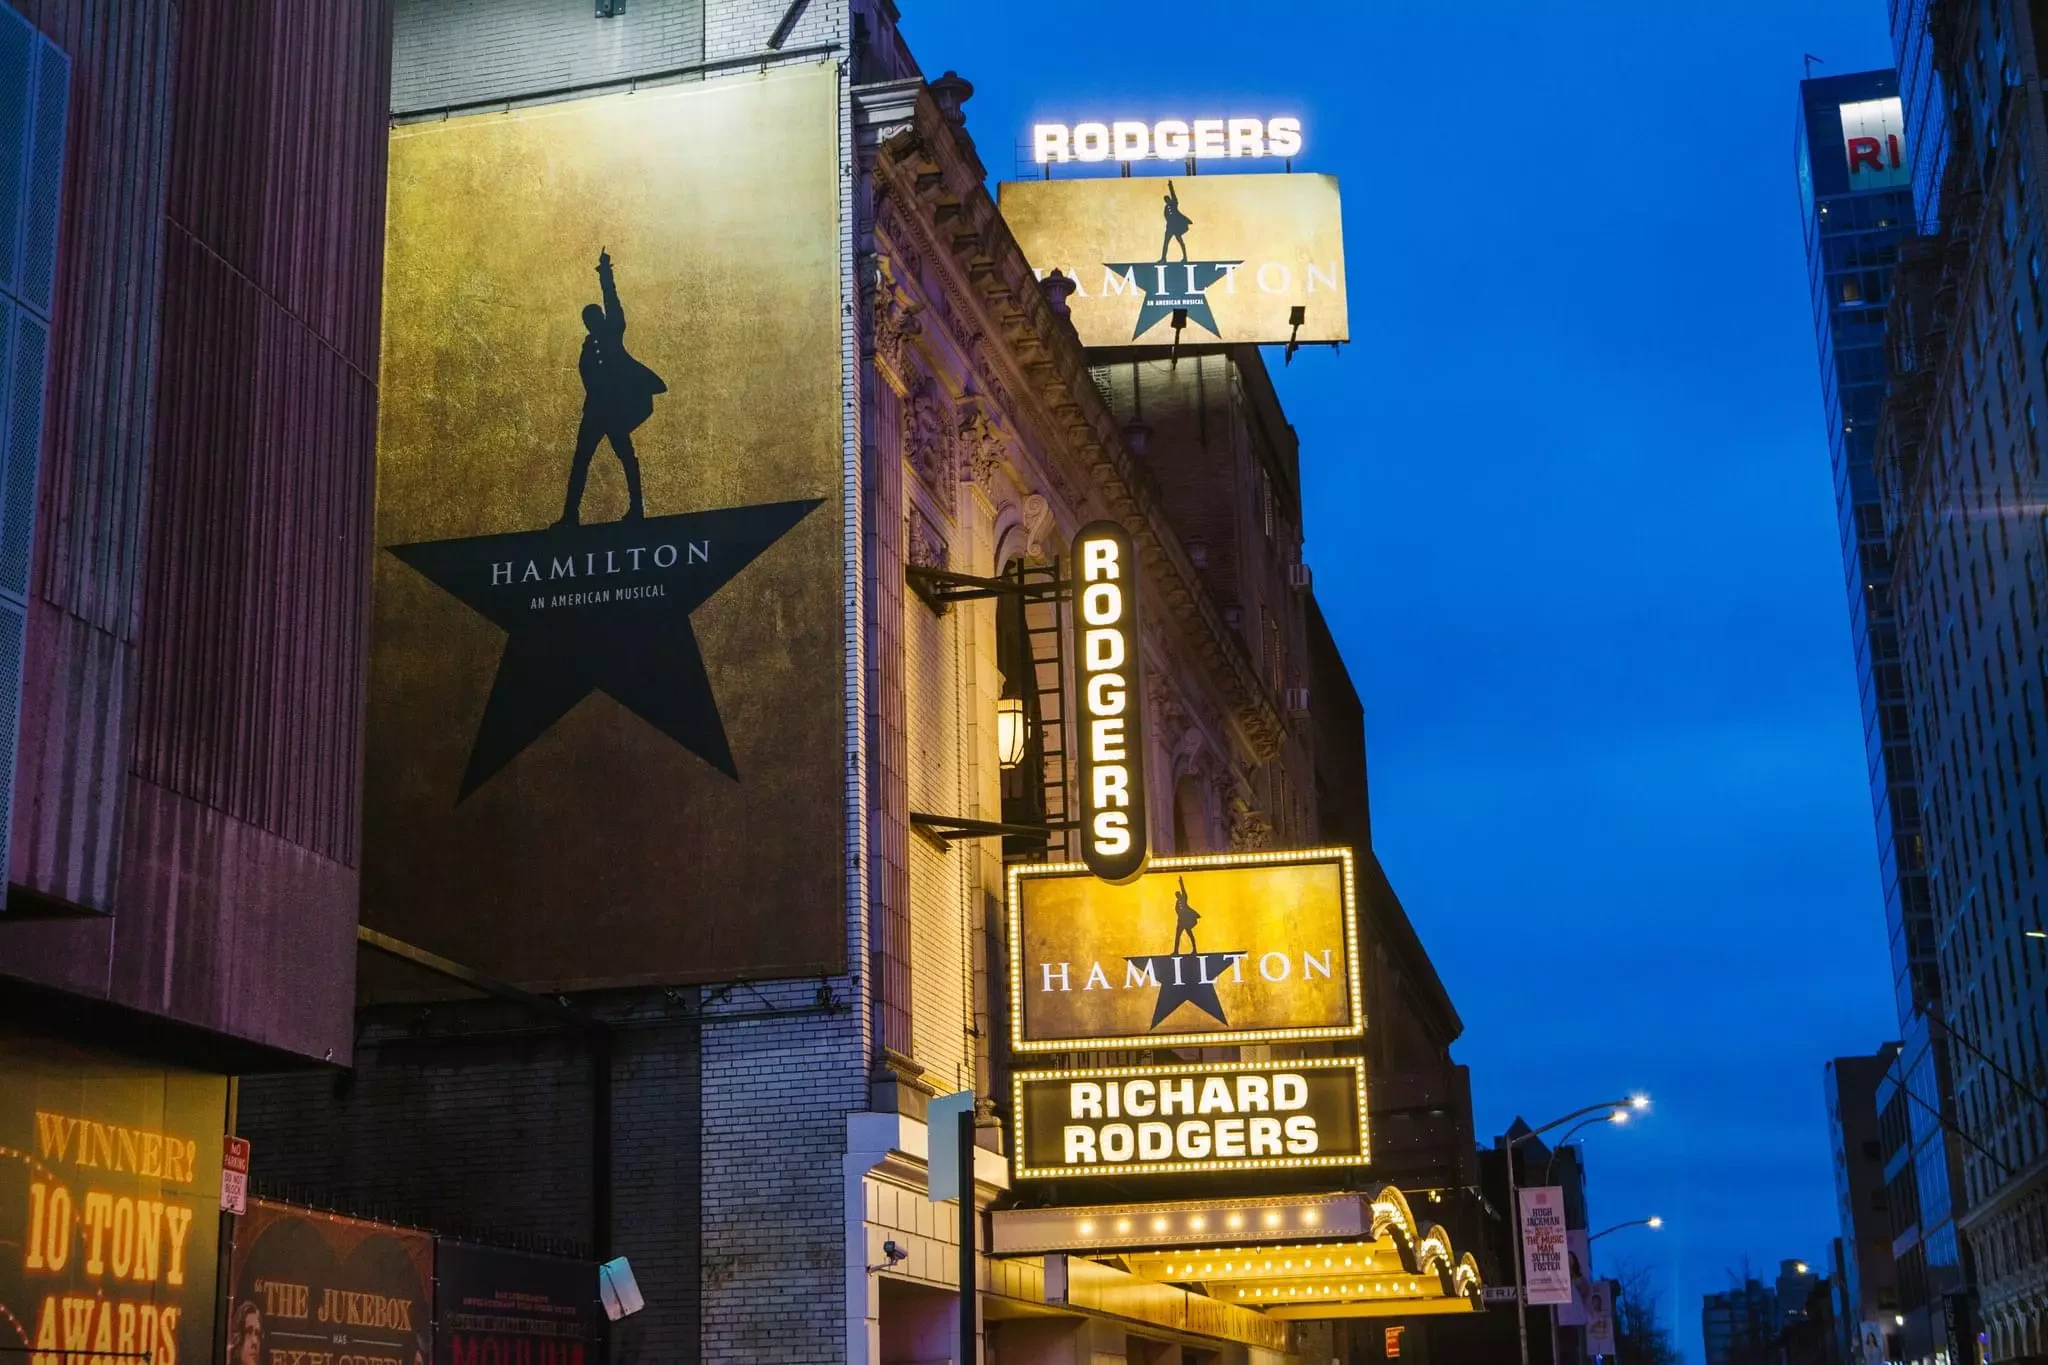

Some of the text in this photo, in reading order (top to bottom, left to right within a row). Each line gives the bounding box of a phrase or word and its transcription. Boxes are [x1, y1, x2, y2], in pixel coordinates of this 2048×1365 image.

[1033, 117, 1302, 164] RODGERS
[1847, 133, 1901, 174] RI
[490, 540, 711, 586] HAMILTON
[530, 584, 665, 610] AN AMERICAN MUSICAL
[1083, 539, 1132, 856] RODGERS
[1040, 949, 1332, 993] HAMILTON
[1070, 1073, 1309, 1120] RICHARD
[36, 1111, 196, 1183] WINNER!
[224, 1153, 246, 1170] PARKING
[231, 1142, 242, 1156] NO
[1063, 1115, 1319, 1164] RODGERS
[224, 1171, 243, 1185] DO NOT
[26, 1182, 193, 1285] 10 TONY
[1526, 1216, 1560, 1227] JACKMAN
[1532, 1207, 1553, 1217] HUGH
[1526, 1235, 1539, 1245] THE
[31, 1296, 178, 1365] AWARDS
[317, 1288, 413, 1332] JUKEBOX
[333, 1333, 349, 1345] HAS
